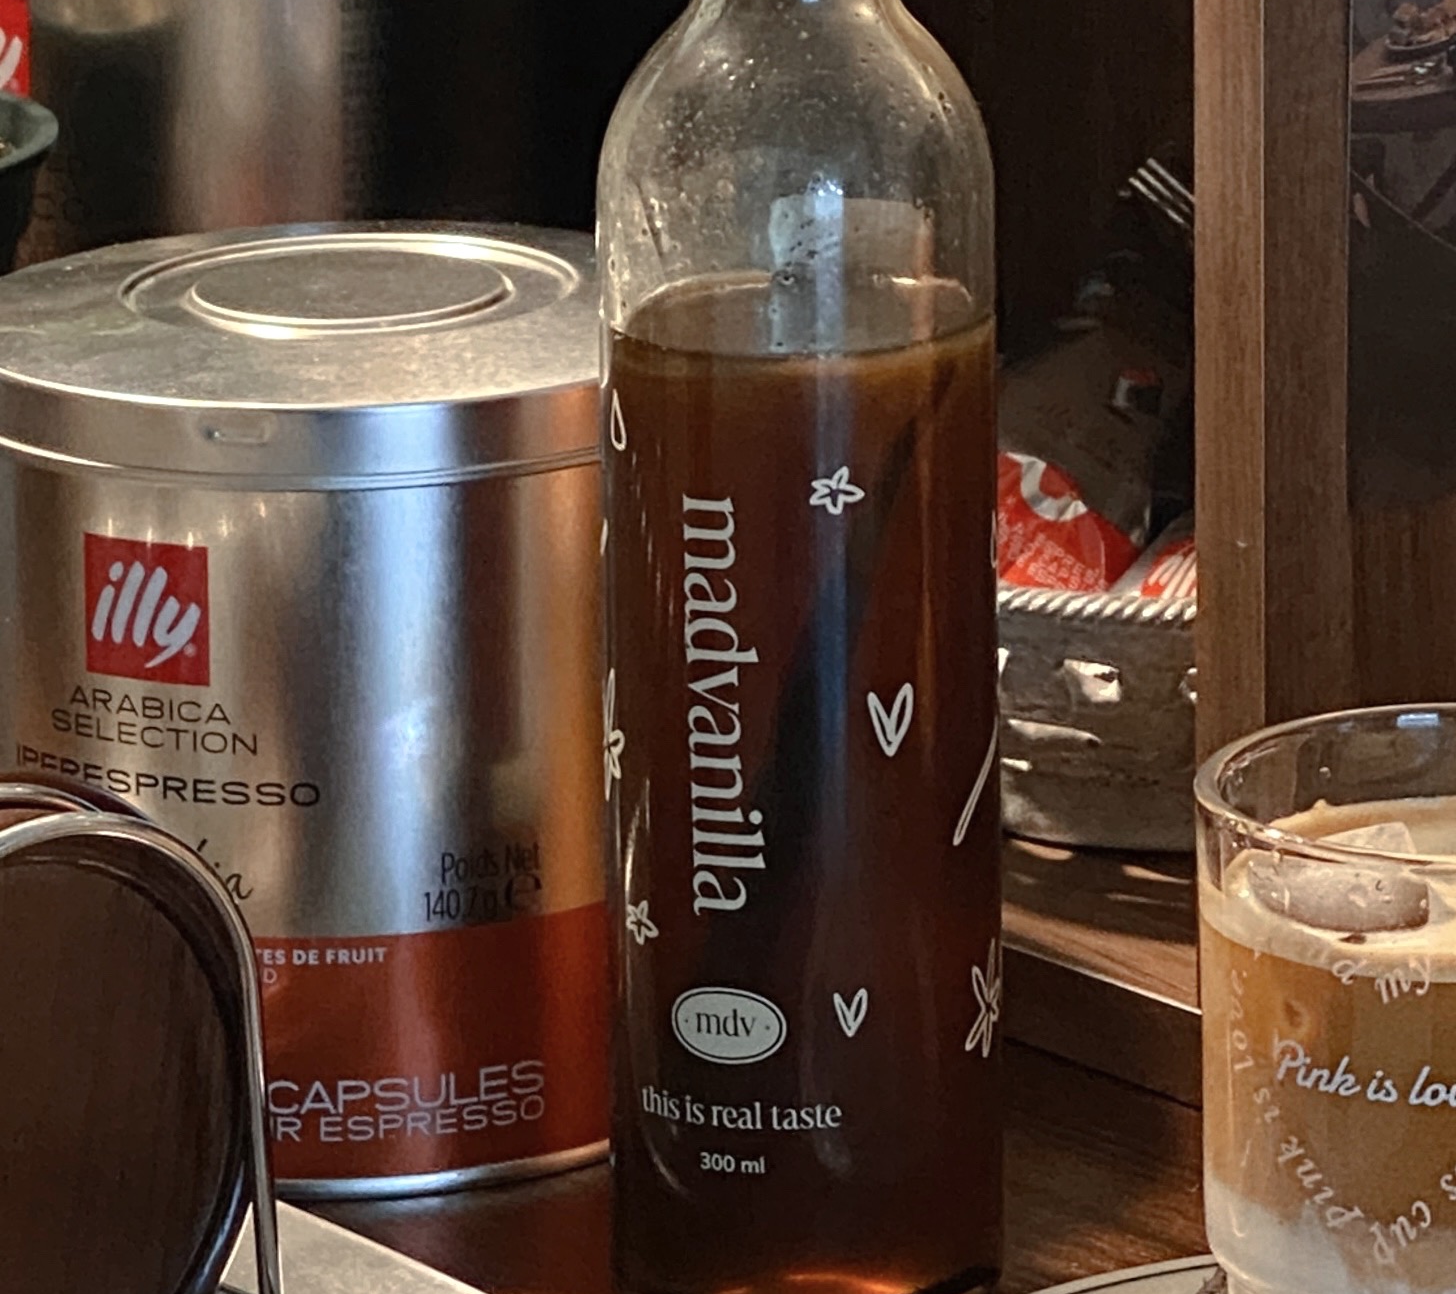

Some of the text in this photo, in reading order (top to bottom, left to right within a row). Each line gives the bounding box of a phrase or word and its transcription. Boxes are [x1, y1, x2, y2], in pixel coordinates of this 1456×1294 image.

[91, 561, 200, 669] illy
[70, 685, 231, 725] ARABICA
[682, 493, 766, 916] madvanilla
[51, 708, 258, 756] SELECTION
[292, 949, 319, 965] DE
[325, 947, 387, 964] FRUIT
[1375, 955, 1431, 1005] my
[696, 1009, 756, 1037] mdv
[268, 1060, 546, 1115] CAPSULES
[1274, 1039, 1361, 1098] Pink
[1367, 1070, 1398, 1103] is
[320, 1095, 545, 1142] ESPRESSO
[642, 1085, 842, 1130] this is real taste
[700, 1152, 766, 1174] 300 ml
